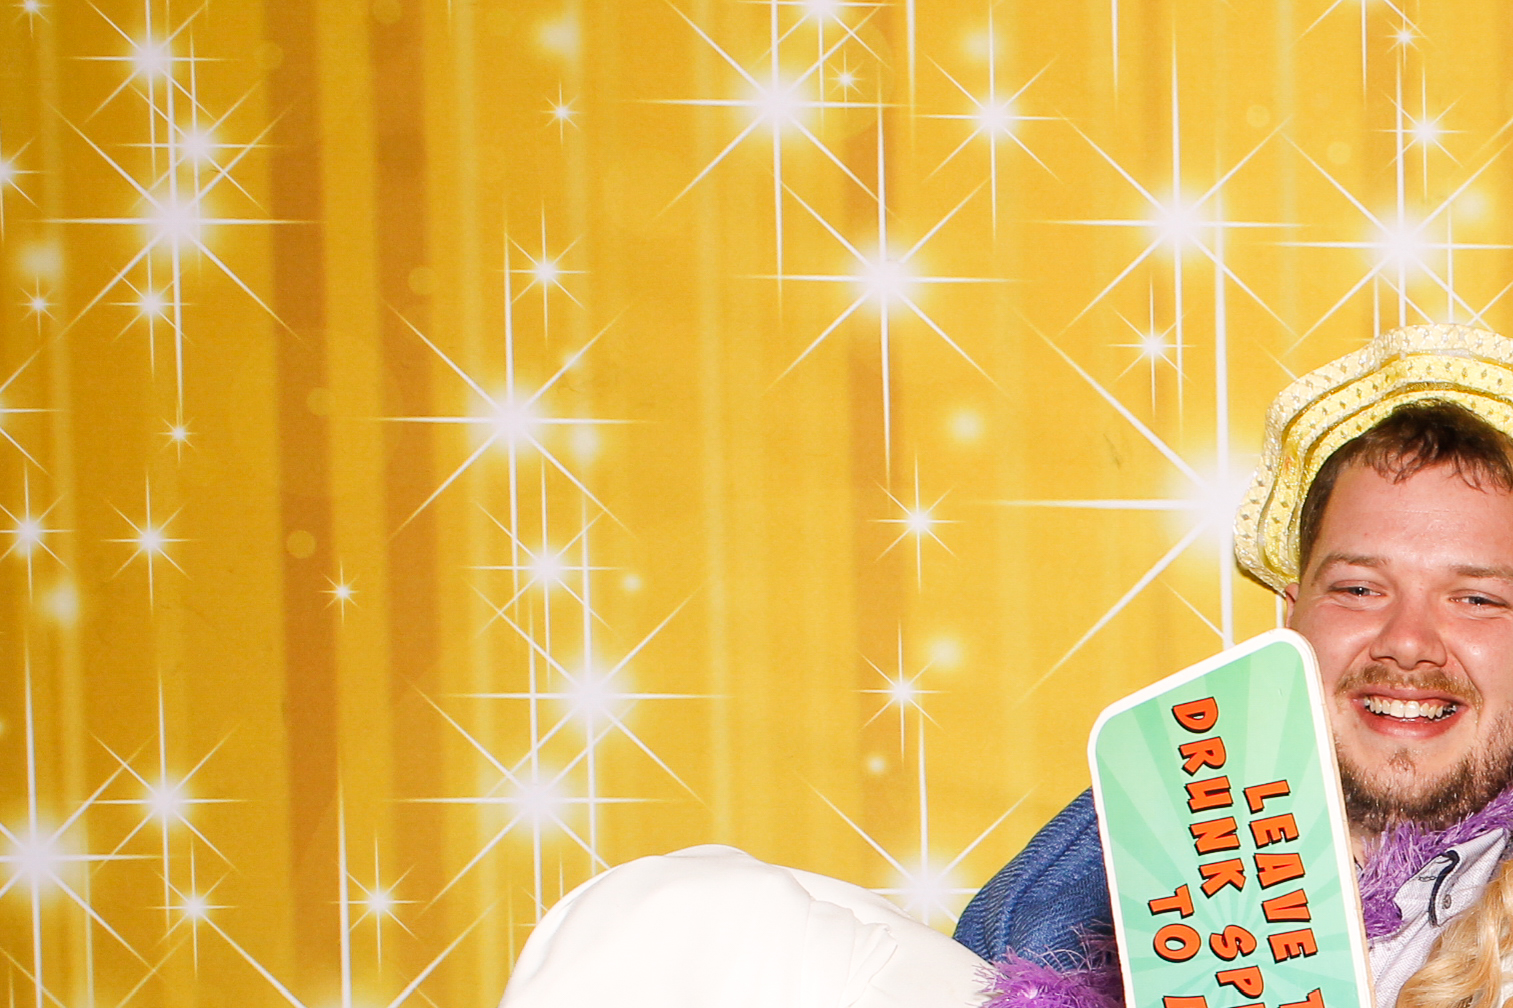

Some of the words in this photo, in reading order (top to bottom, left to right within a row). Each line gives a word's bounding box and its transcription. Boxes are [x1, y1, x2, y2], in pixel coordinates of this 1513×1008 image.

[1171, 696, 1247, 899] DRUNK
[1243, 779, 1318, 964] LEAVE
[1147, 883, 1202, 964] TO
